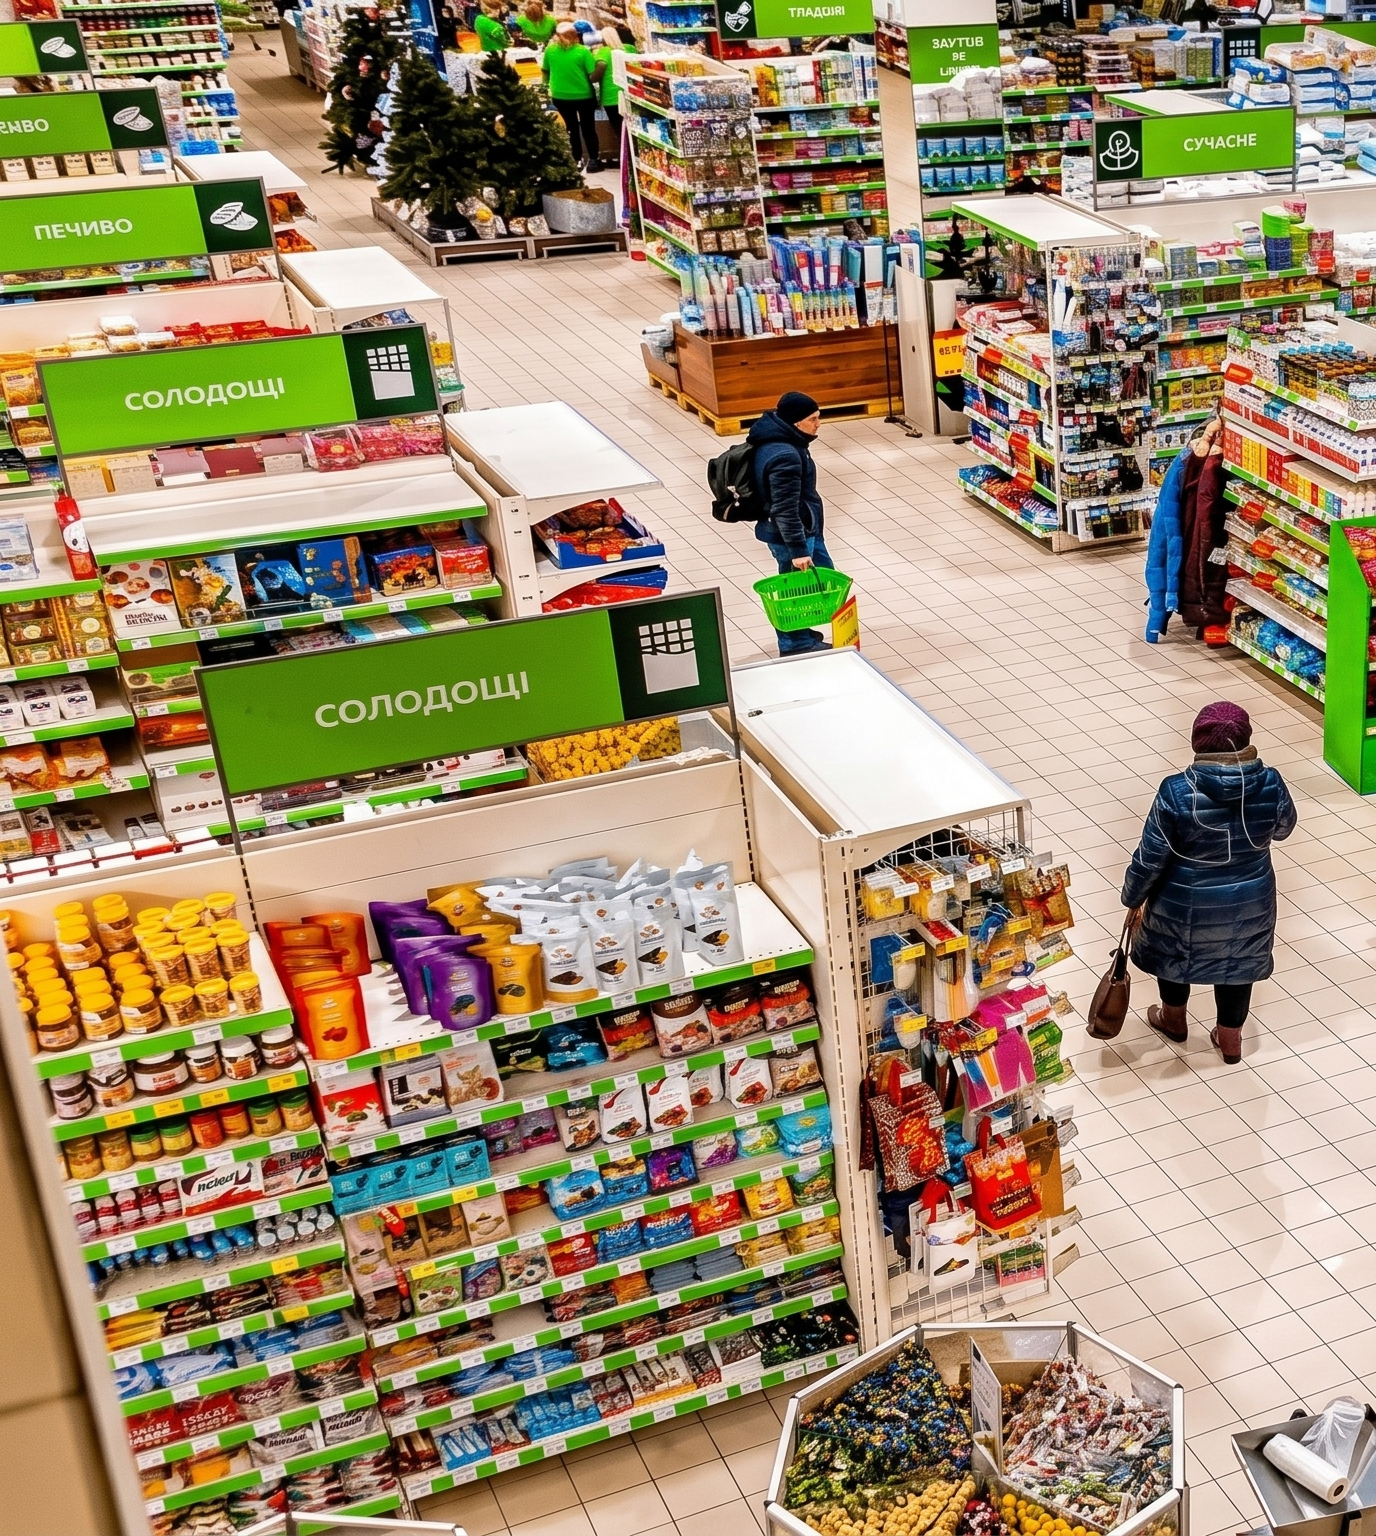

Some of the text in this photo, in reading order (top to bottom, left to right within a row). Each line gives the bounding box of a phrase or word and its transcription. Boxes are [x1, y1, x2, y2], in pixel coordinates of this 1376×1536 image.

[1183, 132, 1257, 152] СУЧАСНЕ
[33, 217, 133, 241] ПЕЧИВО
[124, 377, 286, 412] СОЛОДОЩІ
[314, 670, 531, 728] СОЛОДОЩІ
